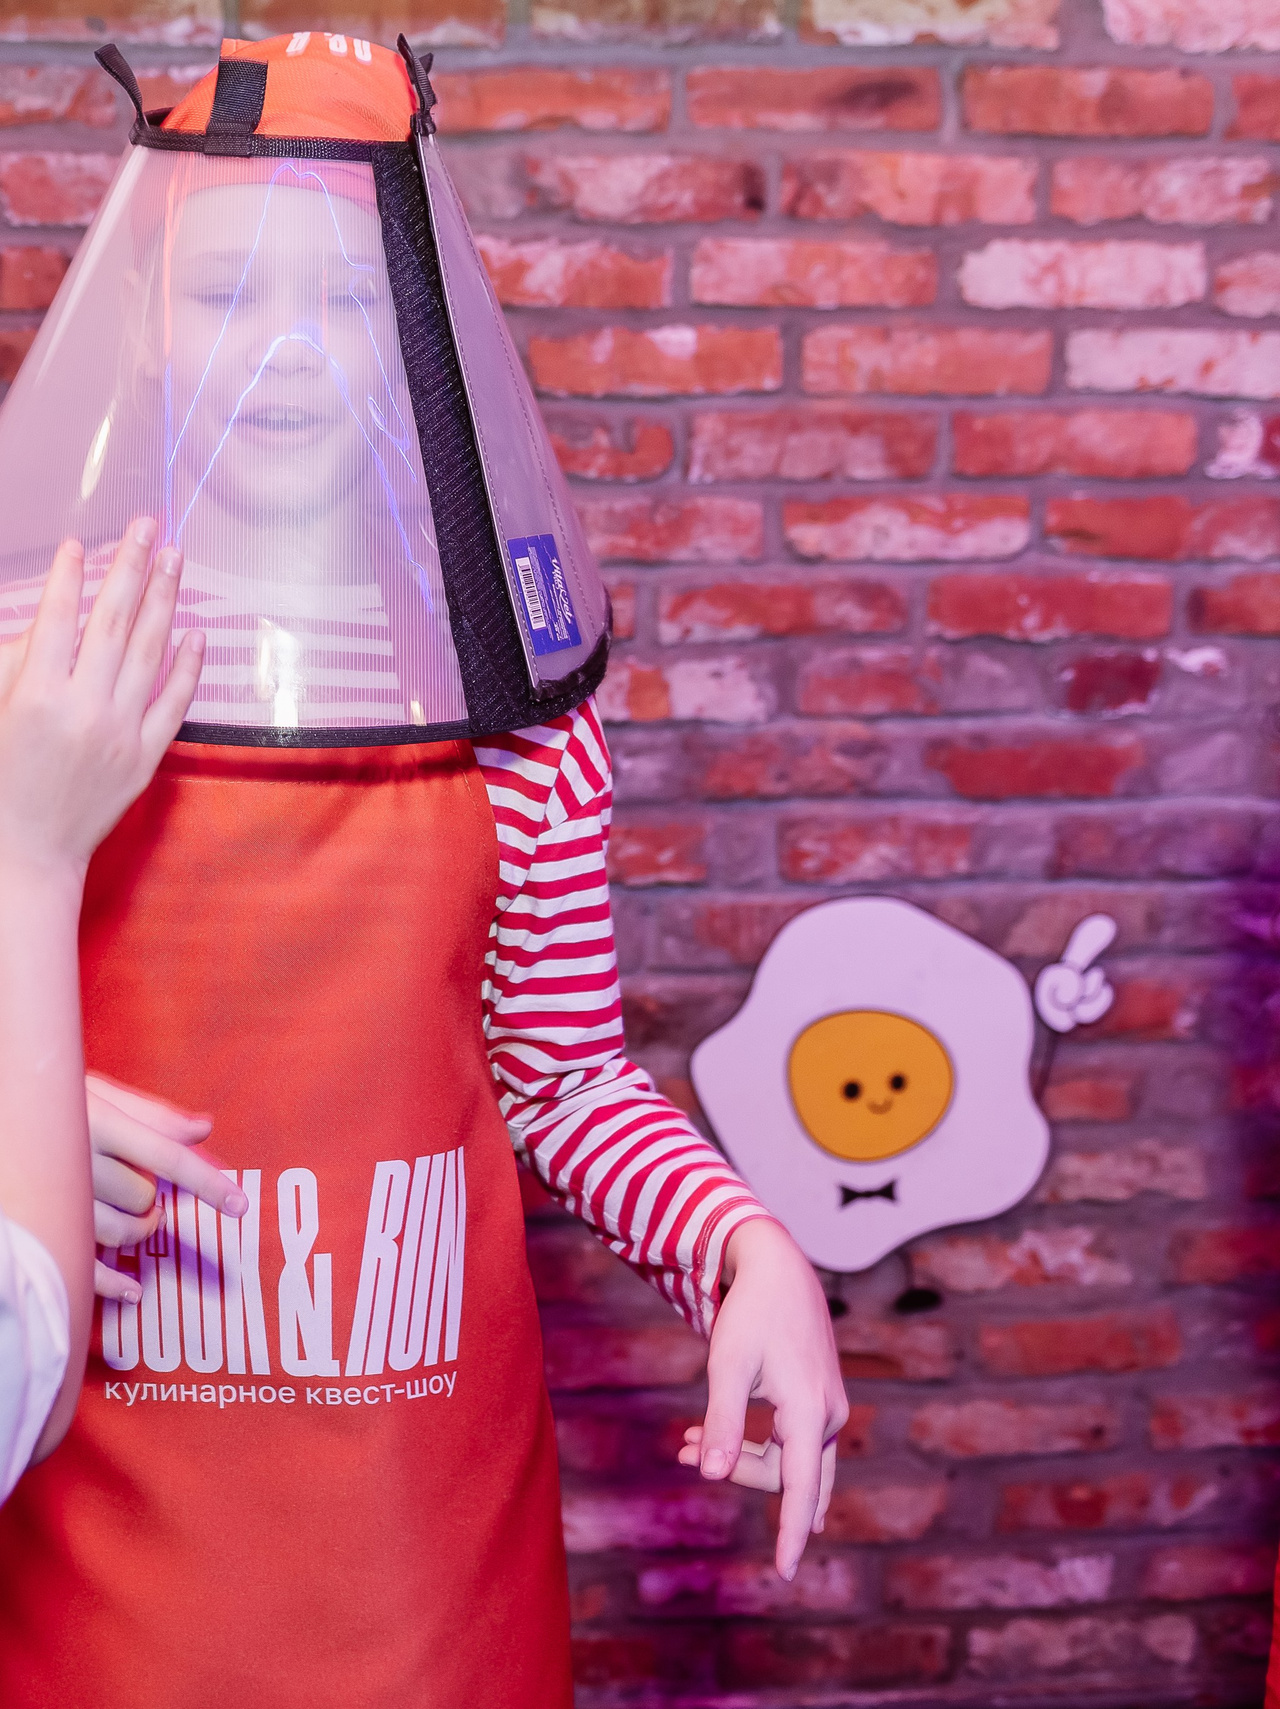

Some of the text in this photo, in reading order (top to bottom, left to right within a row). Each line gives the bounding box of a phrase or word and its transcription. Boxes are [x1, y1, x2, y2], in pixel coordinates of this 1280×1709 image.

[277, 1167, 340, 1377] &
[345, 1146, 467, 1377] RUN
[104, 1371, 458, 1409] кулинарное квест-шоу
